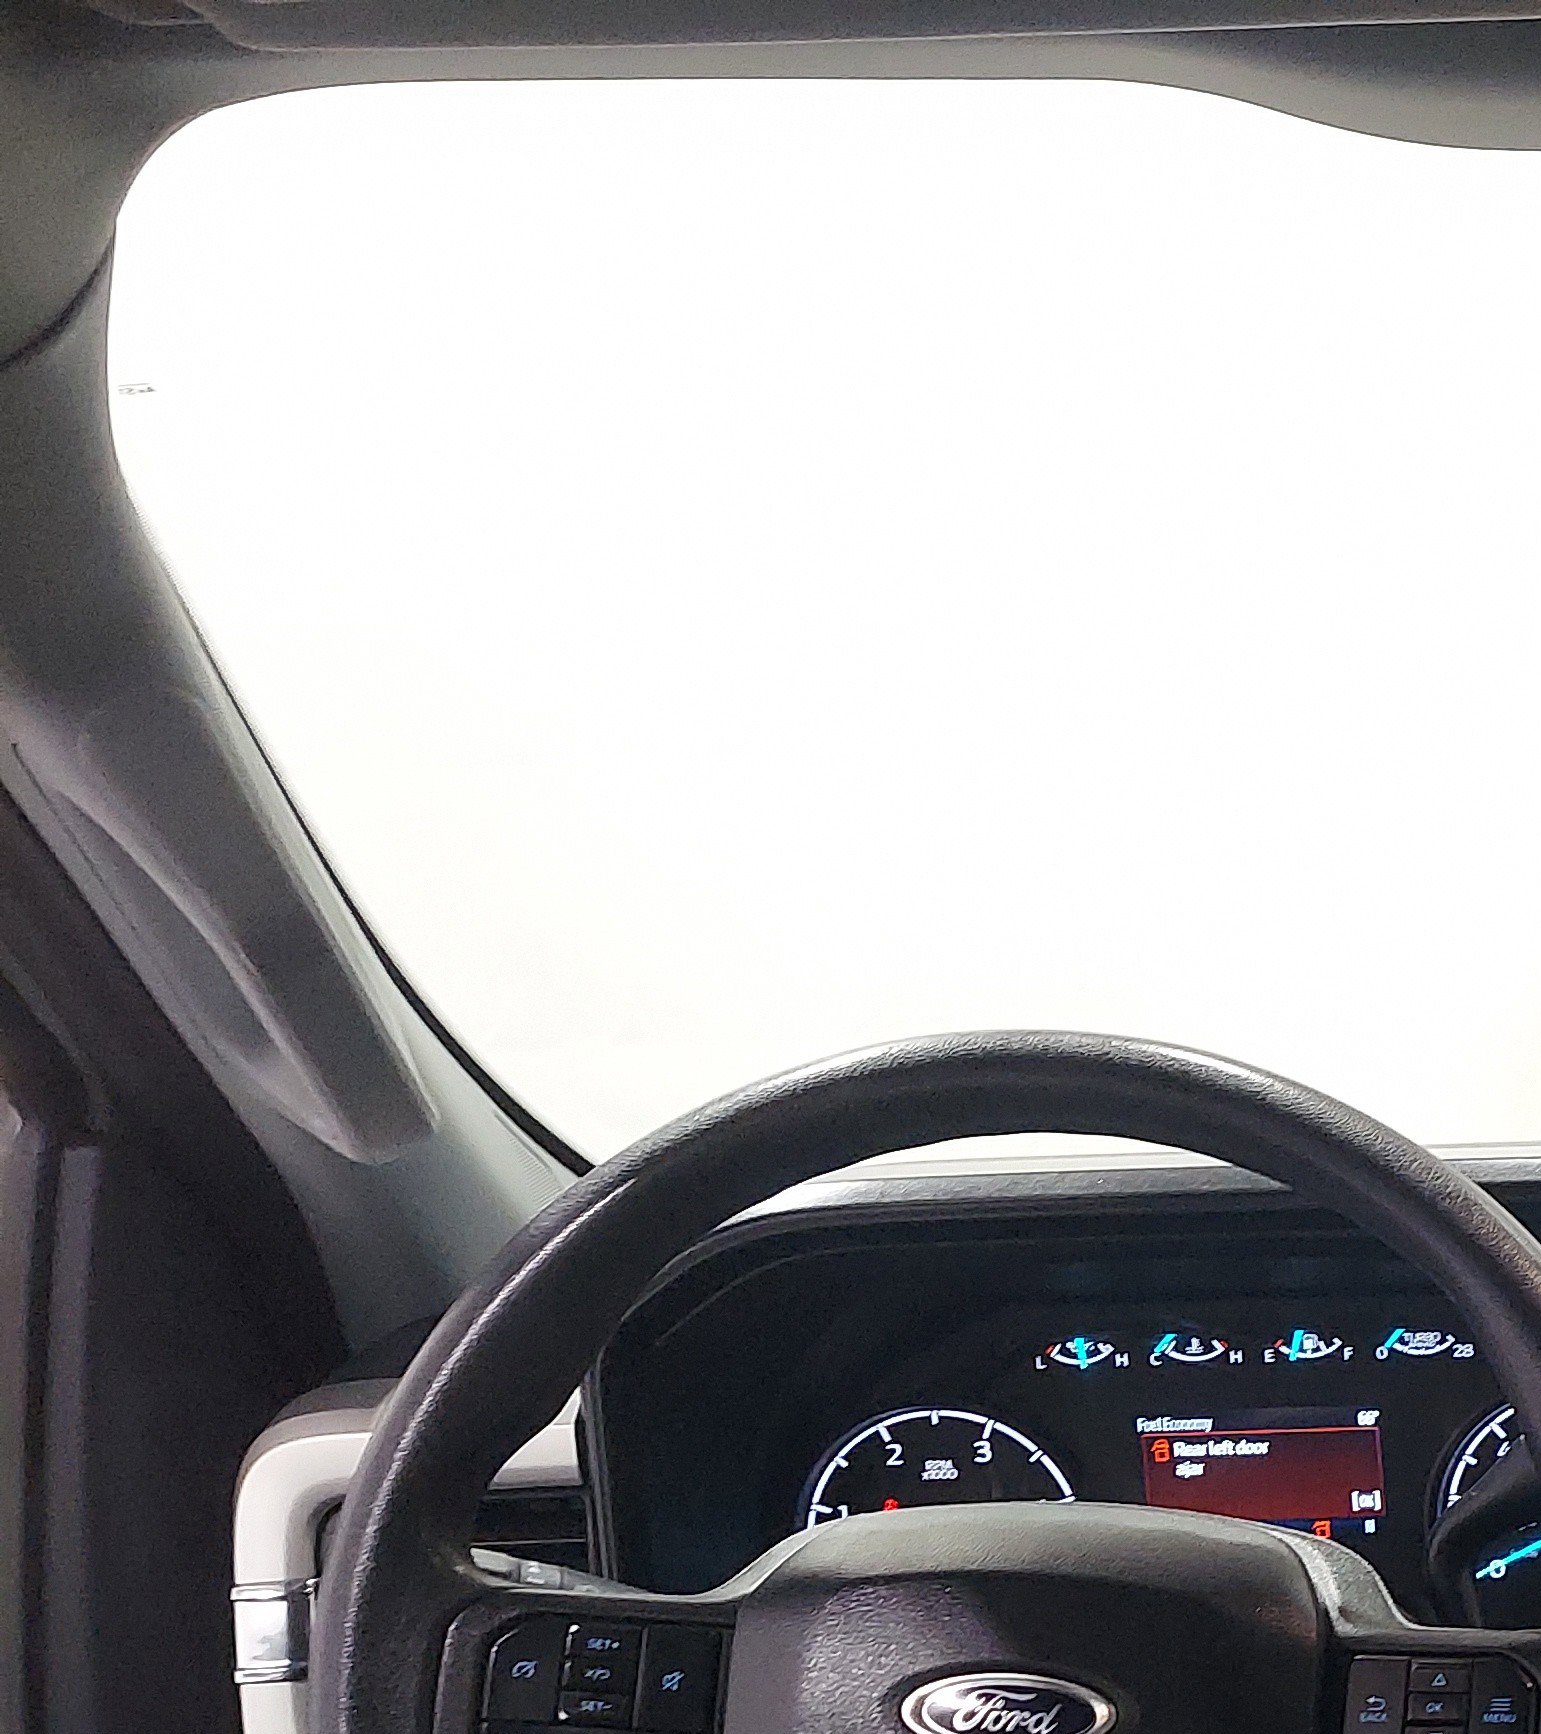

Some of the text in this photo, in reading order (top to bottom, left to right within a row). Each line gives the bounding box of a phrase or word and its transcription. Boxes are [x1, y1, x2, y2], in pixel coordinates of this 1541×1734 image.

[1115, 1353, 1130, 1368] H
[1149, 1352, 1162, 1367] C
[1229, 1349, 1243, 1363] H
[1264, 1350, 1276, 1363] E
[1343, 1347, 1354, 1361] F
[1035, 1355, 1047, 1369] L
[885, 1443, 904, 1466] 2
[972, 1440, 993, 1463] 3
[1173, 1439, 1269, 1457] Rear left door
